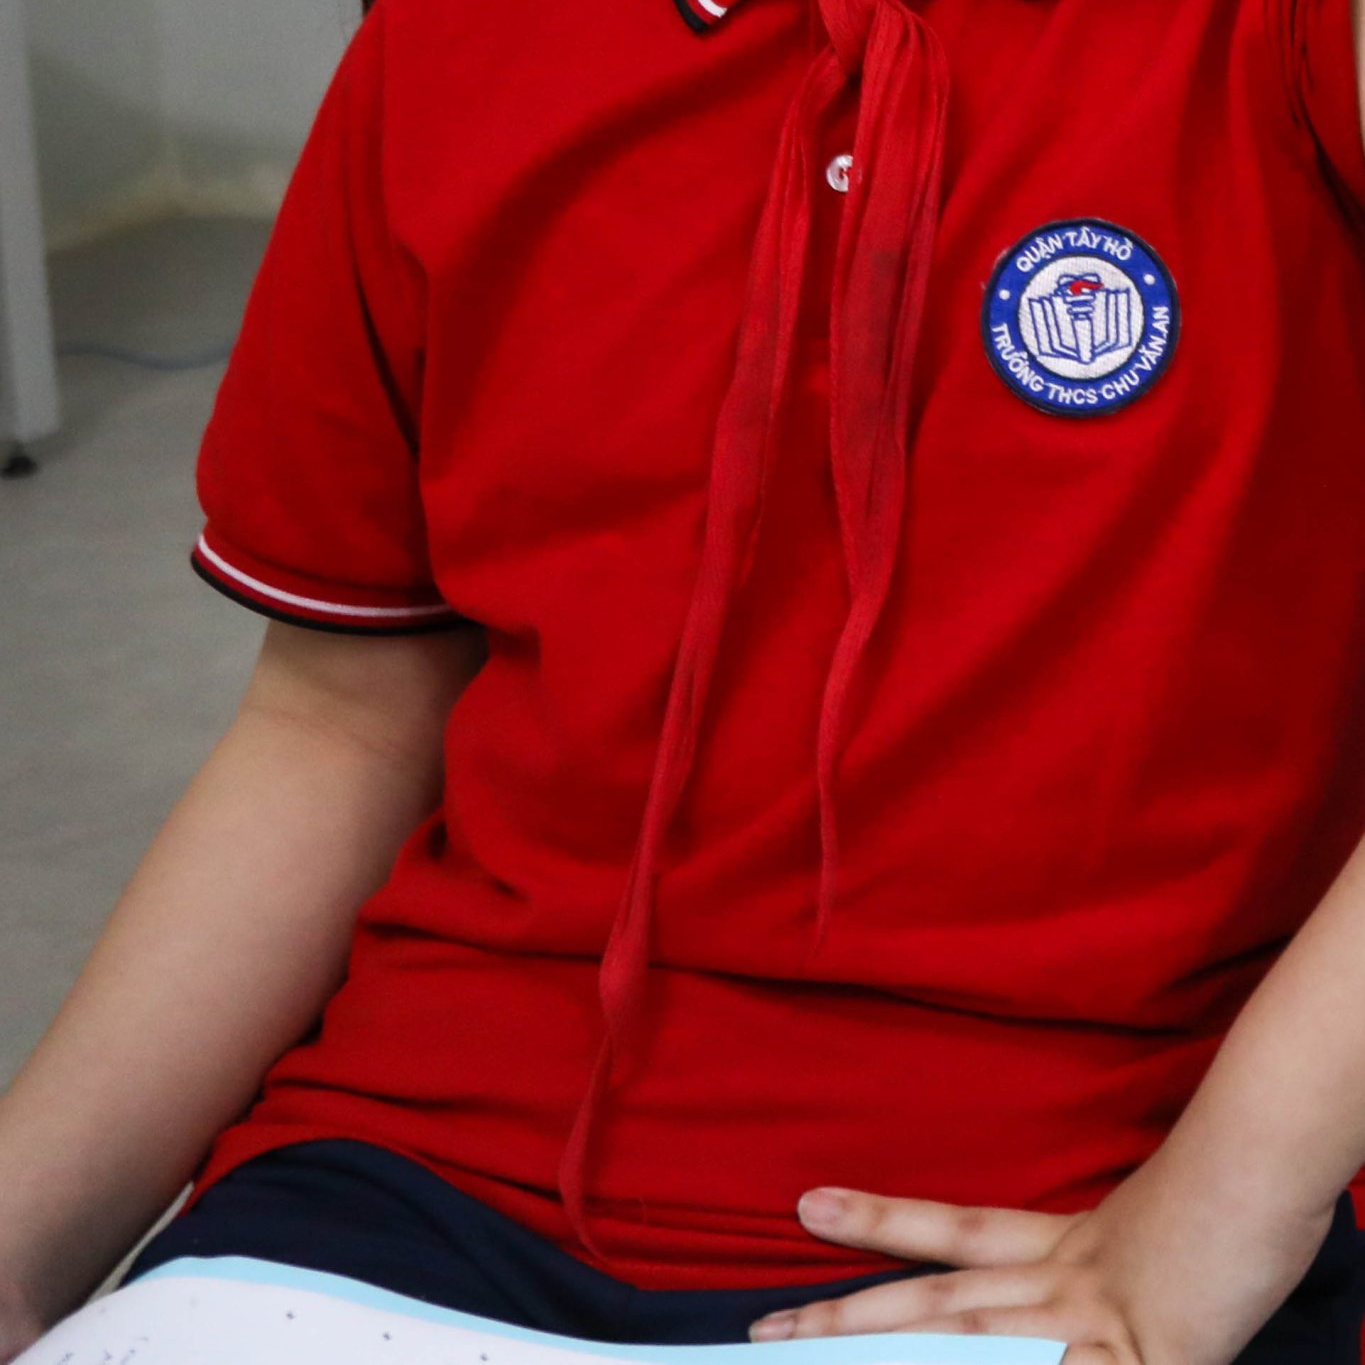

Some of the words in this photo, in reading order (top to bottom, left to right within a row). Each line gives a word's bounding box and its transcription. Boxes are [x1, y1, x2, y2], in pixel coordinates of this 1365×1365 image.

[1016, 232, 1063, 272] QUẬN
[1065, 225, 1101, 249] TÂY
[1103, 237, 1134, 261] HỒ
[991, 322, 1045, 392] TRƯỜNG
[1046, 383, 1099, 405] THCS
[1101, 369, 1140, 400] CHU
[1133, 334, 1167, 371] VĂN
[1151, 306, 1170, 334] AN
